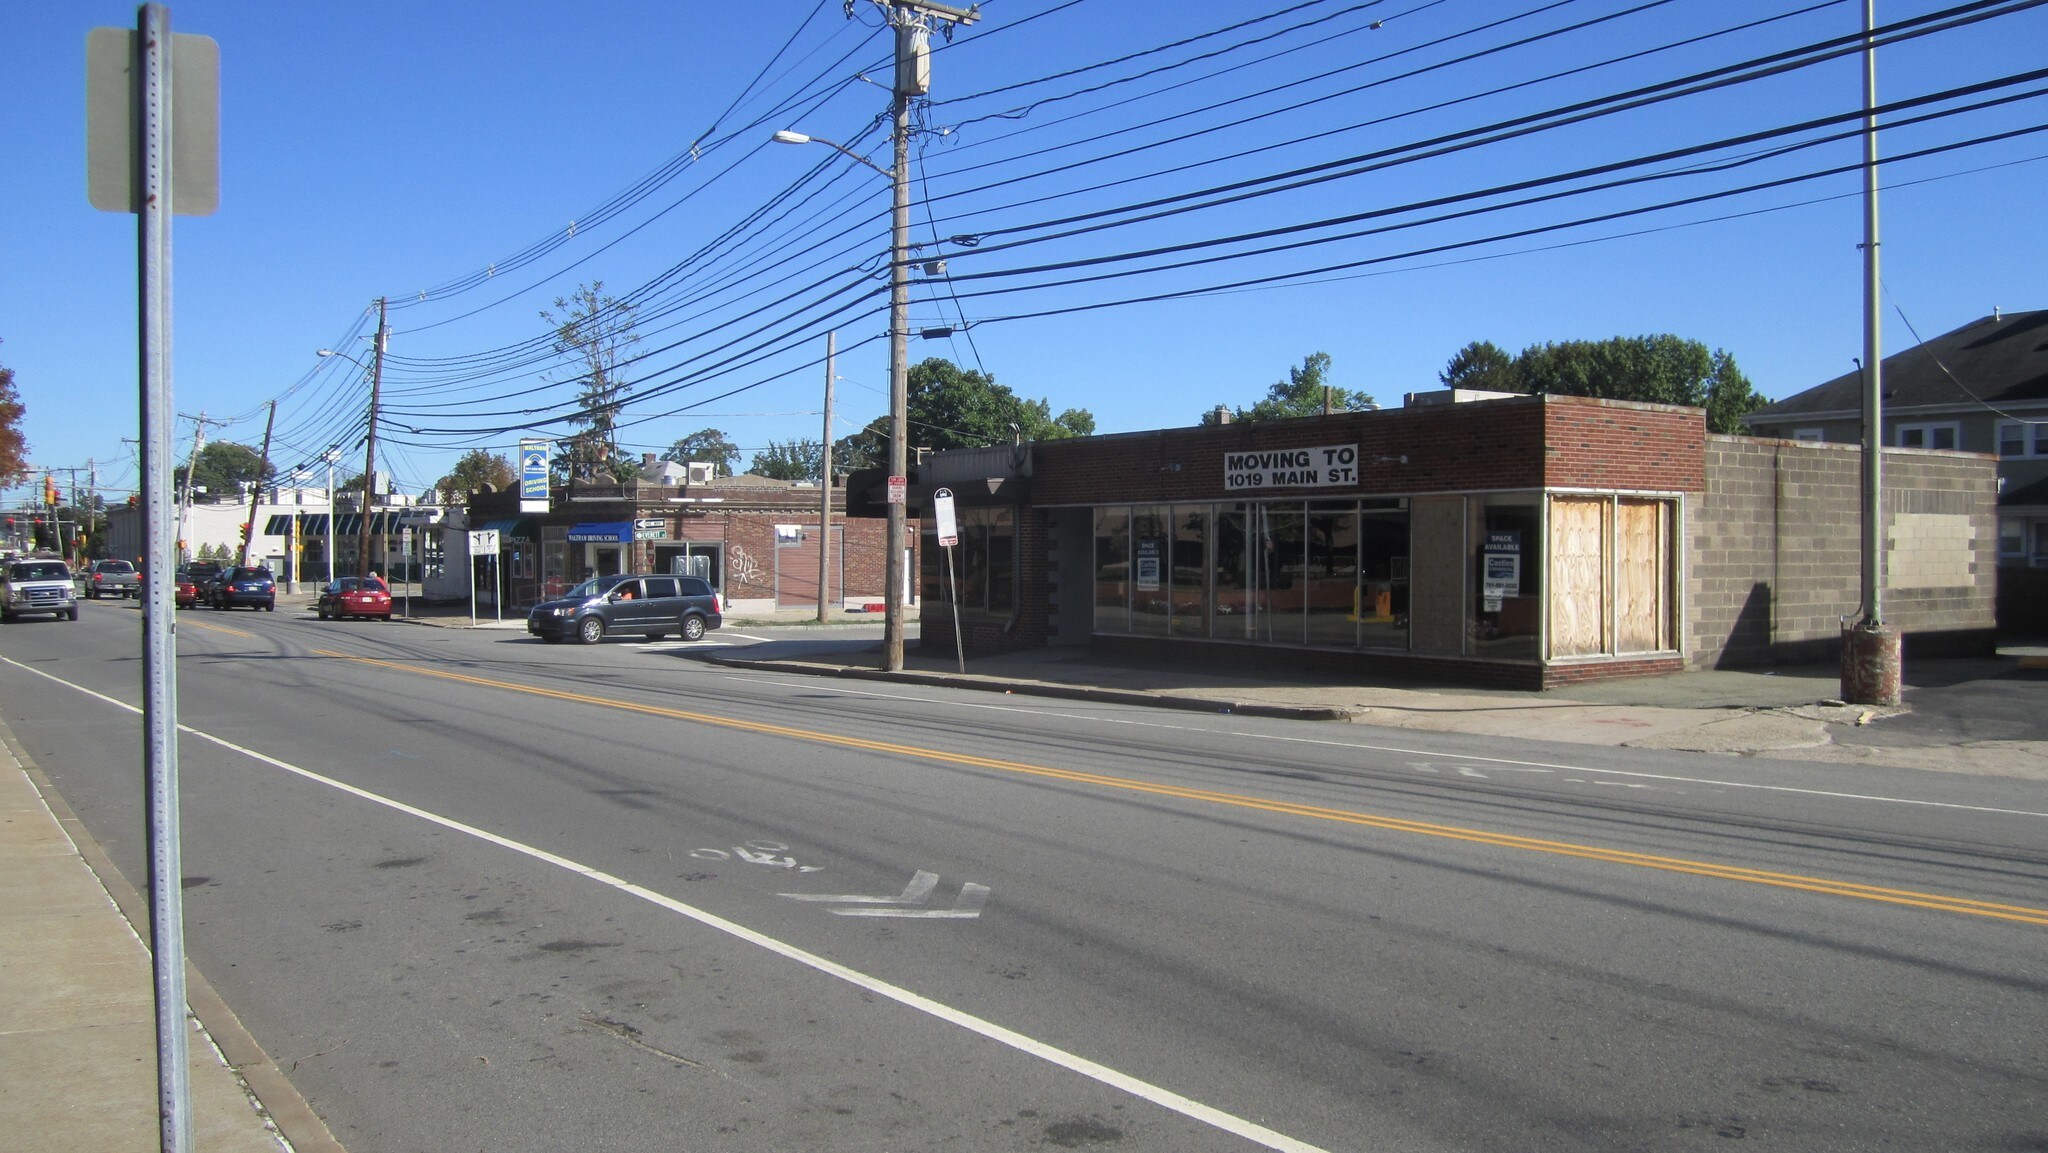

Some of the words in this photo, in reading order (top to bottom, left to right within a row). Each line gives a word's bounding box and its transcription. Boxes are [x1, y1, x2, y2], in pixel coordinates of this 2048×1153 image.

[1228, 451, 1310, 471] MOVING
[1322, 447, 1355, 466] TO
[524, 477, 547, 486] DRIVING
[1227, 473, 1263, 487] 1019
[1272, 470, 1318, 485] MAIN
[1328, 468, 1356, 483] ST.
[525, 485, 547, 494] SCHOOL
[642, 531, 660, 539] EVERETT
[1489, 558, 1514, 567] Castles
